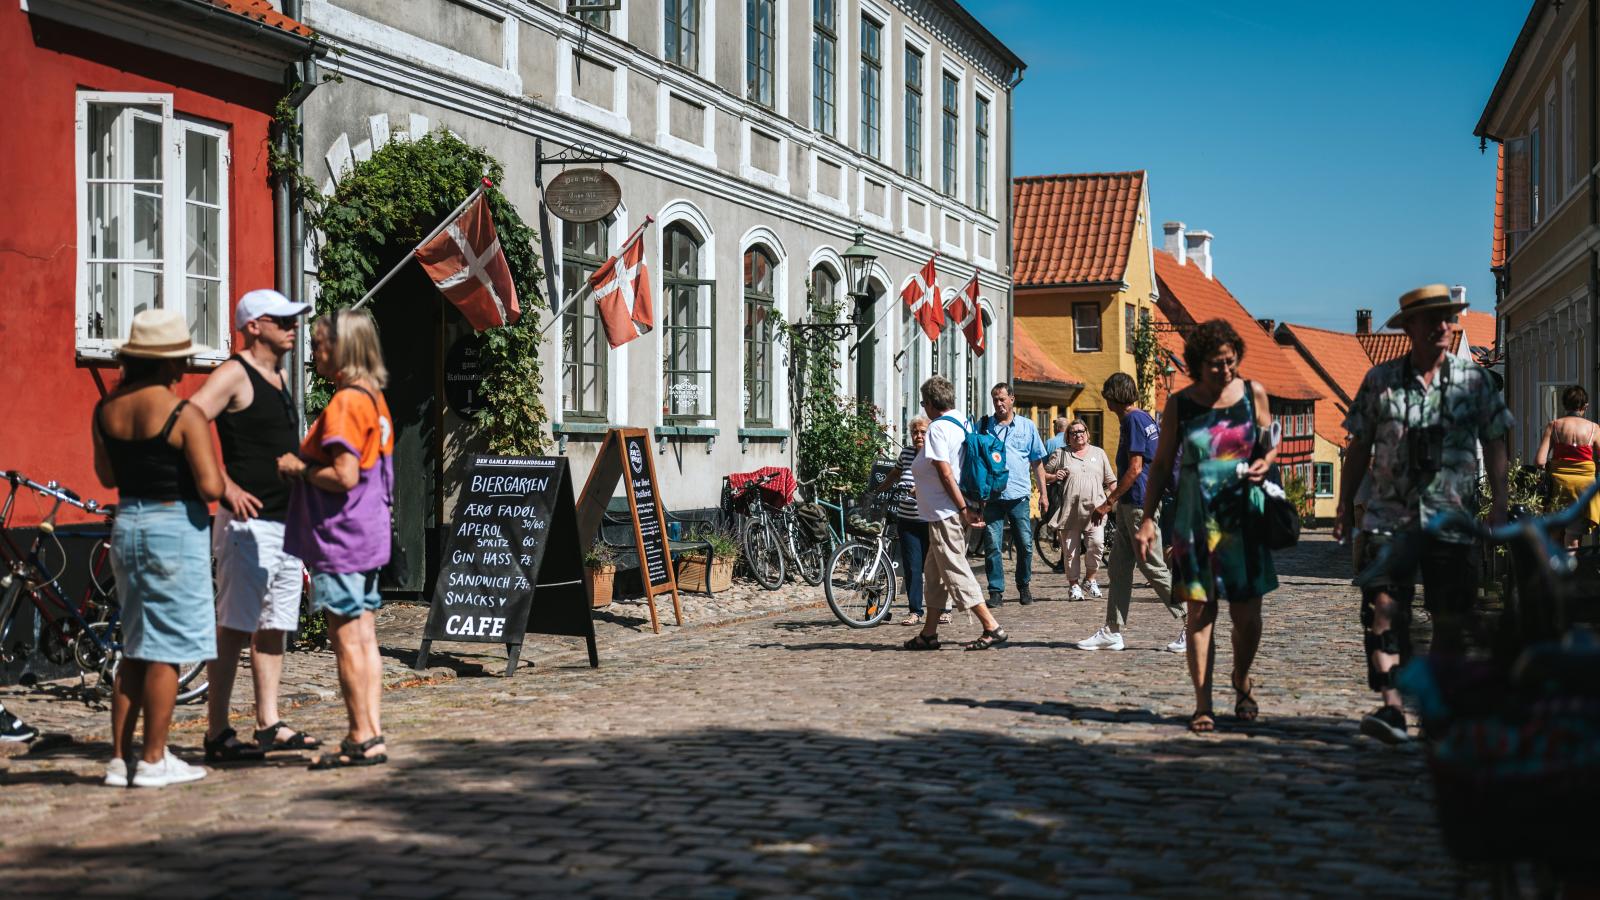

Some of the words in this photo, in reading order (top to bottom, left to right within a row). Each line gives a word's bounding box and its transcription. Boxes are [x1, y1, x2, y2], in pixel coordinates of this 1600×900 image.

[471, 475, 549, 494] BIERGARTEN
[464, 503, 493, 516] ÆRØ
[498, 504, 536, 518] FADØL
[457, 522, 502, 538] APEROL
[477, 537, 509, 547] SPRITZ
[452, 549, 475, 565] GIN
[483, 552, 512, 566] HASS
[448, 572, 510, 588] SANDWICH
[445, 591, 495, 608] SNACKS
[446, 614, 506, 637] CAFE
